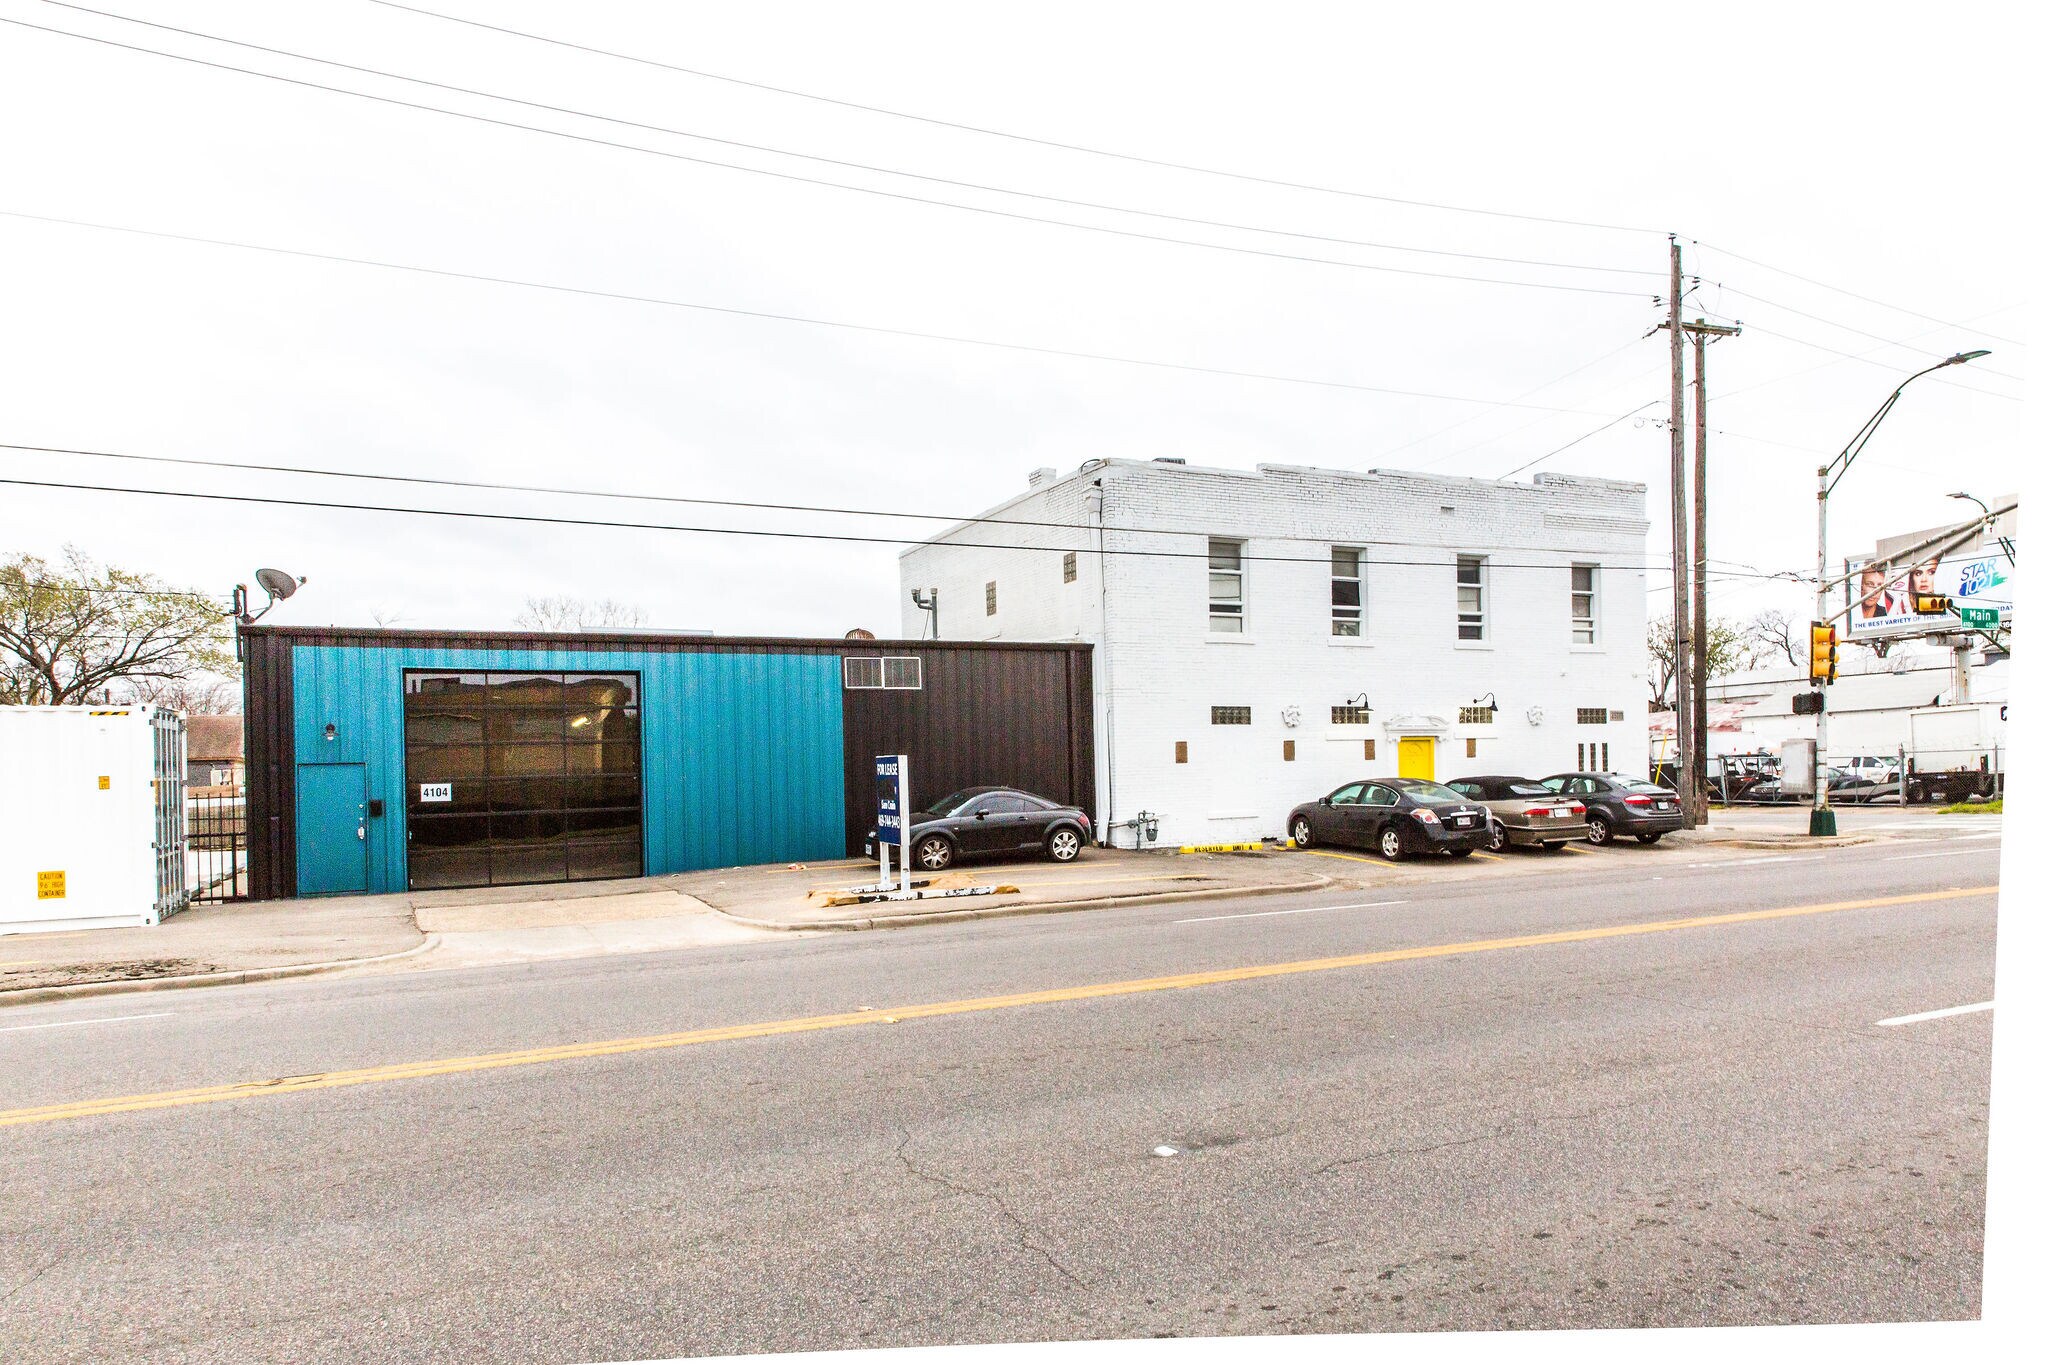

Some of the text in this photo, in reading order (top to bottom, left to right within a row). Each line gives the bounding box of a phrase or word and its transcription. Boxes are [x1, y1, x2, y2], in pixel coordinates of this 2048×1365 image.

[1961, 558, 1997, 581] STAR
[1969, 610, 1991, 621] Main
[1885, 617, 1911, 625] VARIETY
[885, 763, 898, 775] LEASE
[423, 787, 448, 797] 4104
[40, 873, 63, 881] CAUTION
